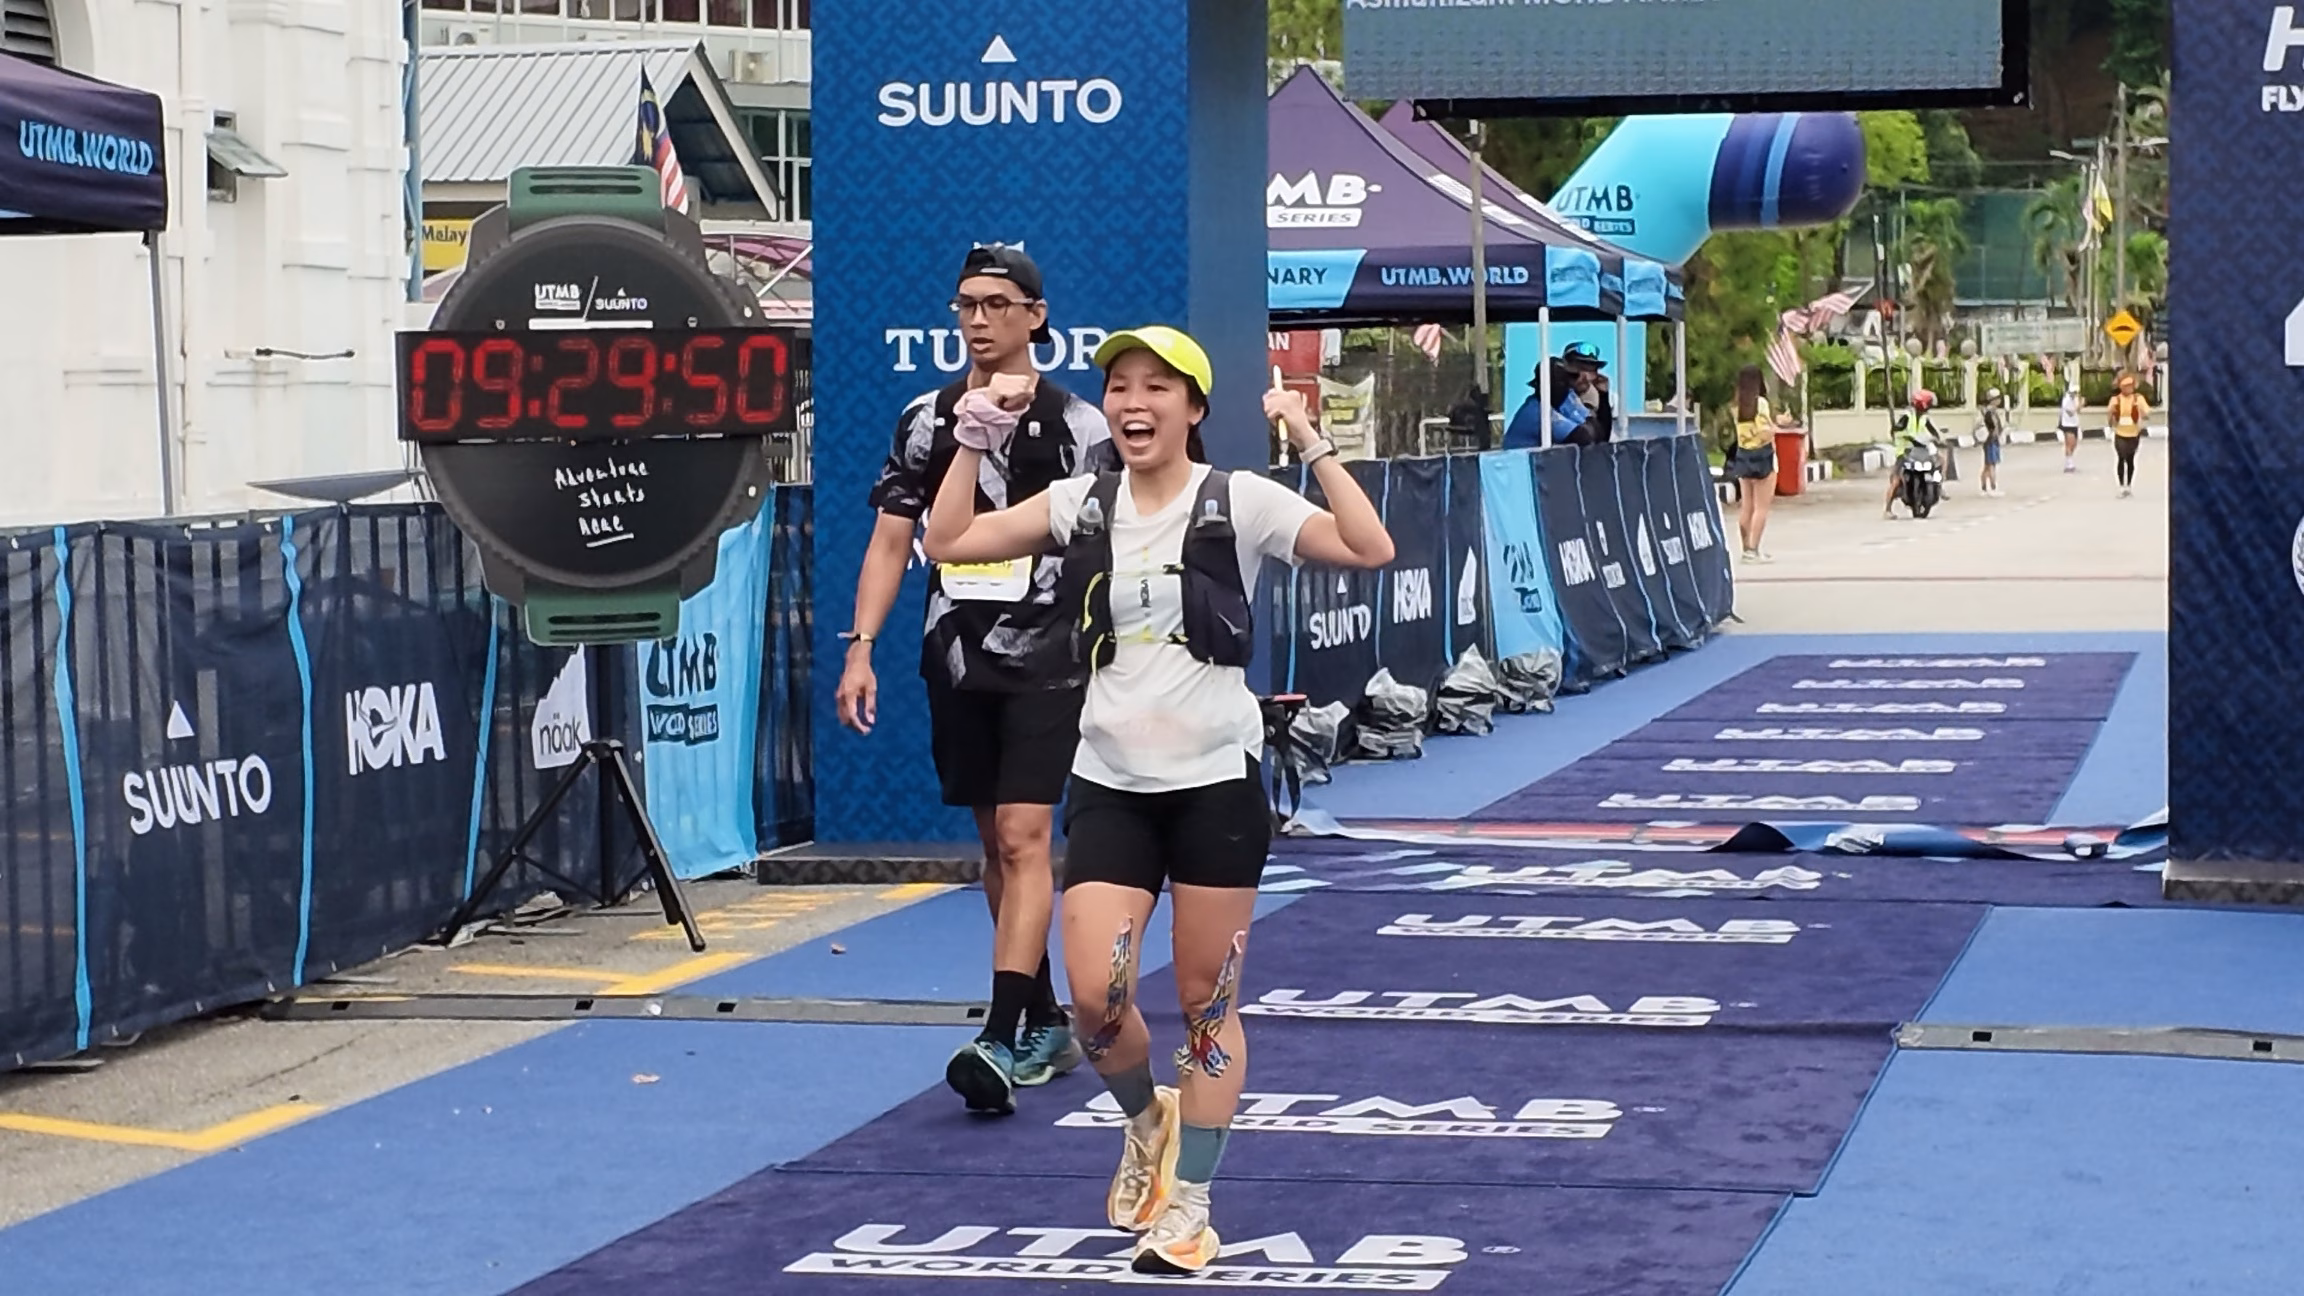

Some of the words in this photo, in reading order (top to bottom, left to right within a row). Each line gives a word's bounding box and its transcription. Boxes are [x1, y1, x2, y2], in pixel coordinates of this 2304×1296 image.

[878, 78, 1123, 127] SUUNTO
[19, 119, 154, 176] UTMB.WORLD
[1556, 184, 1634, 212] UTMB
[1277, 212, 1352, 224] SERIES
[534, 282, 581, 300] UTMB
[594, 297, 649, 311] SUUNTO
[885, 328, 1109, 372] TUOR
[345, 681, 447, 776] HOKA
[123, 753, 272, 835] SUUNTO
[1393, 913, 1801, 932] UTMB
[1258, 989, 1721, 1013] UTMB
[1372, 1123, 1587, 1135] SERIES
[831, 1258, 1125, 1274] WORLD
